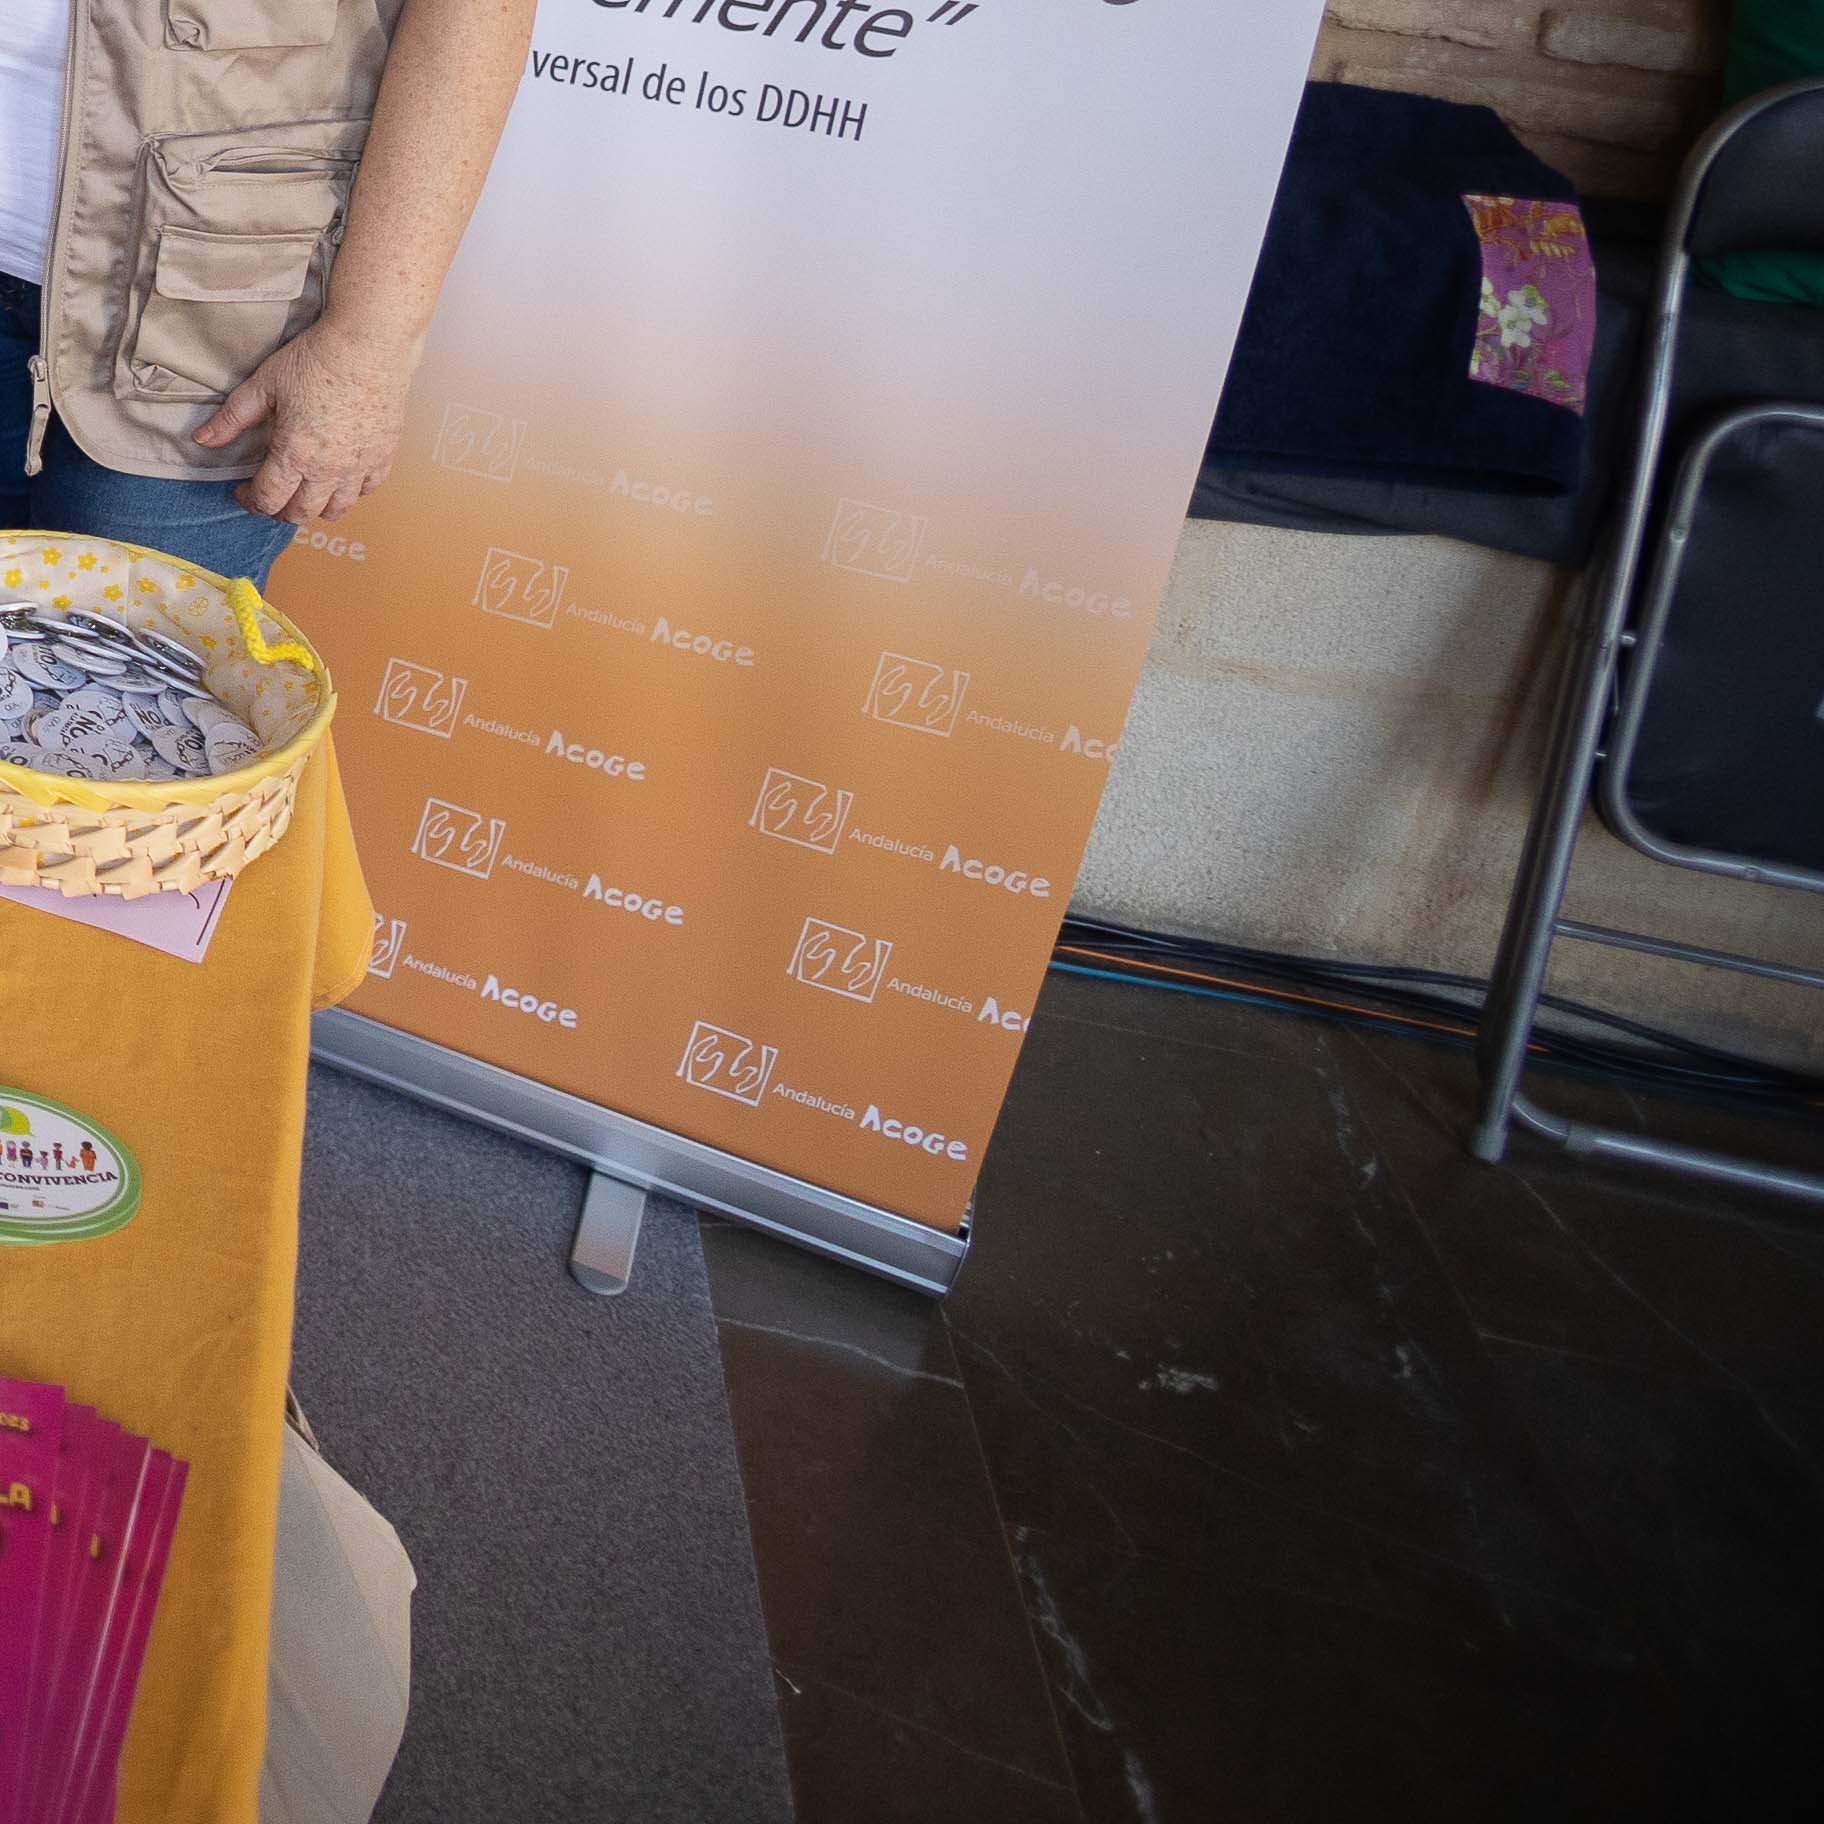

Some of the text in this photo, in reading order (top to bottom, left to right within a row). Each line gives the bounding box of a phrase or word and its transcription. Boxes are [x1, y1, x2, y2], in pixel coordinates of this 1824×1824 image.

[641, 59, 687, 102] de
[697, 69, 747, 119] los
[756, 80, 870, 144] DDHH
[565, 601, 646, 636] Andalucía
[773, 1081, 856, 1121] Andalucía
